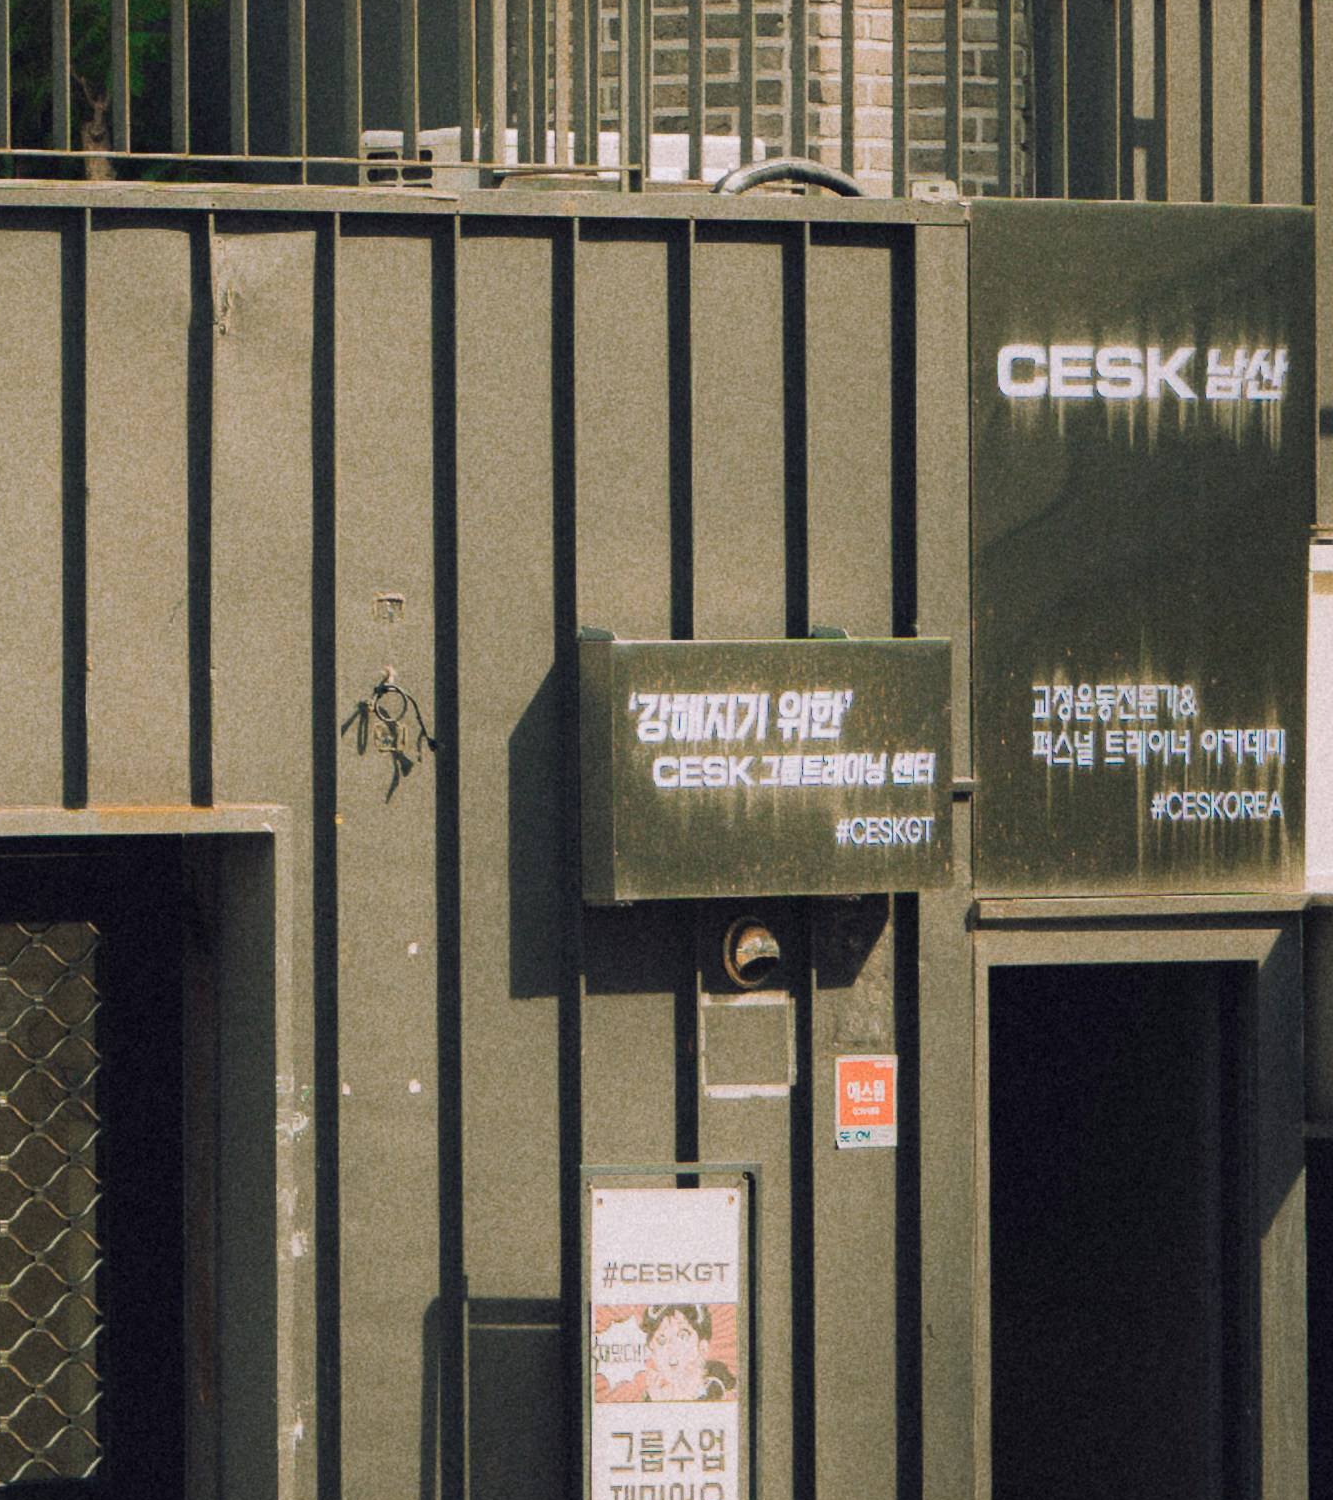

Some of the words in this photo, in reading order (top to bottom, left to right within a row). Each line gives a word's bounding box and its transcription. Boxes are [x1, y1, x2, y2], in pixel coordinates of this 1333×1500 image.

[997, 344, 1198, 399] CESK
[1206, 347, 1289, 400] 남산
[1032, 730, 1094, 766] 퍼스널
[1104, 729, 1191, 765] 트레이너
[1200, 728, 1286, 764] 아카데미
[652, 755, 757, 788] CESK
[759, 753, 889, 787] 그룹트레이닝
[890, 752, 936, 785] 센터
[1150, 790, 1284, 820] #CESKOREA
[835, 815, 936, 846] #CESKGT
[846, 1079, 886, 1104] 에스원
[601, 1261, 730, 1289] #CESKGT
[609, 1428, 726, 1473] 그룹수업
